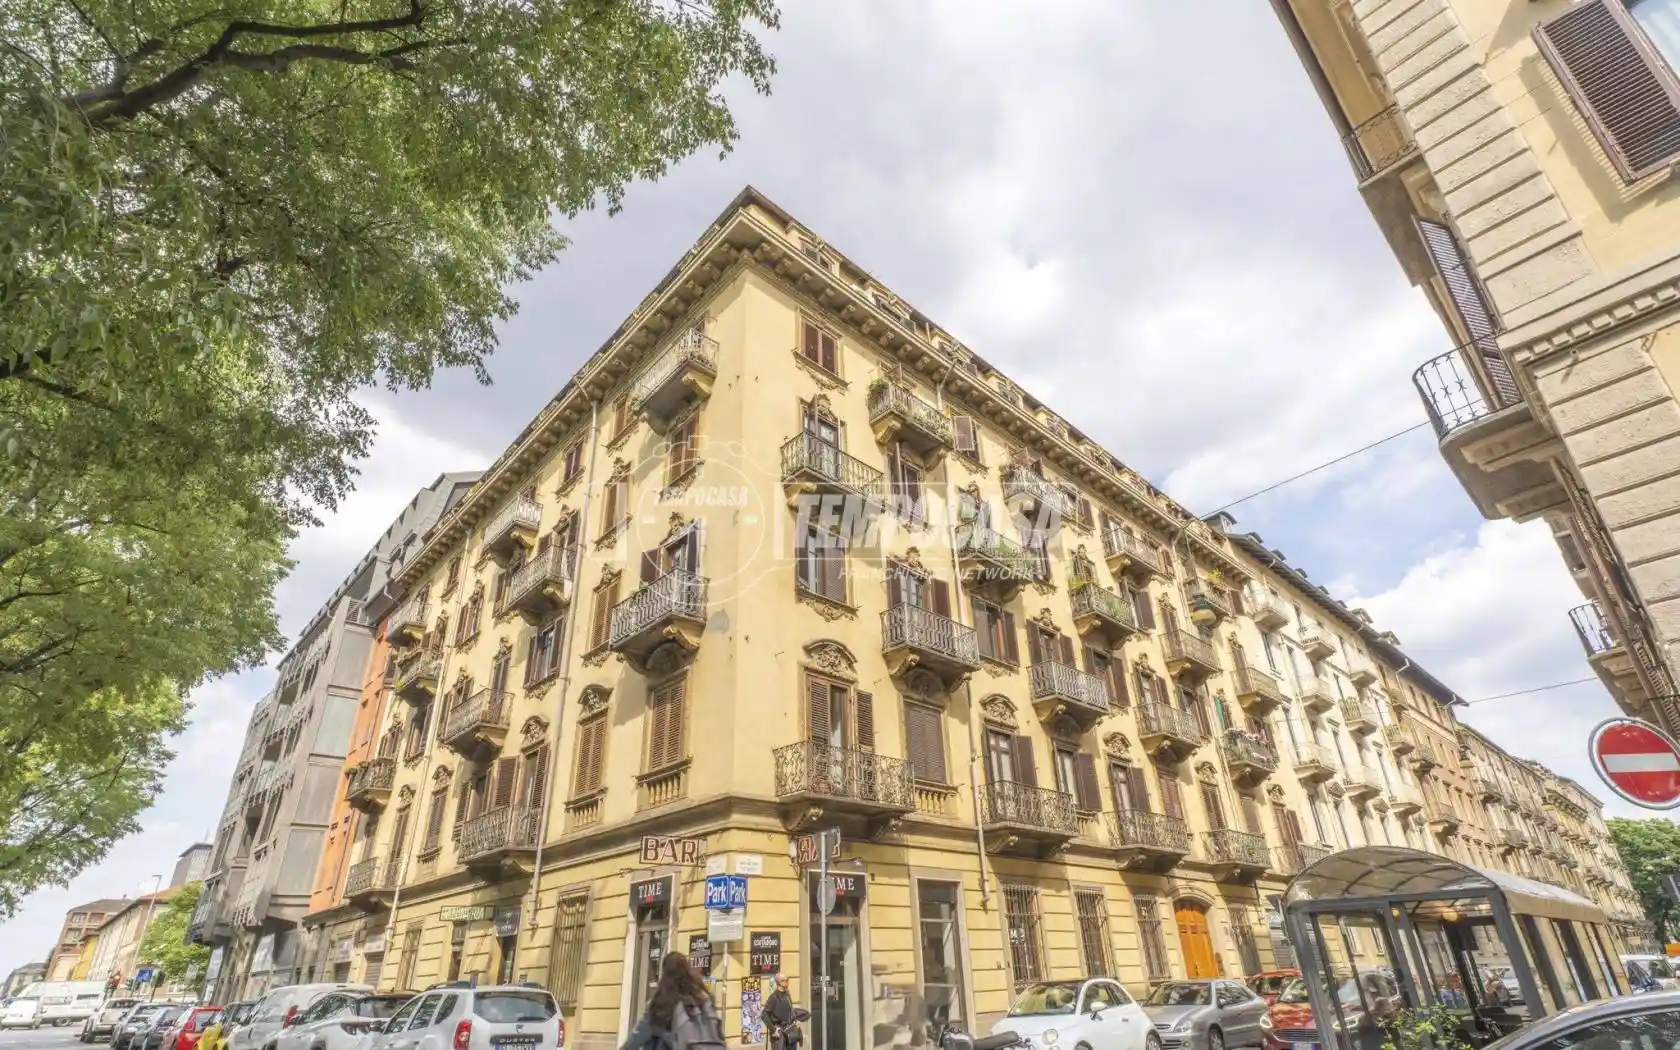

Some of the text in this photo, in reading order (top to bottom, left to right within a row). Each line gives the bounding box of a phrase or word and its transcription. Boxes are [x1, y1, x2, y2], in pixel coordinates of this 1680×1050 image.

[642, 835, 698, 865] BAR
[638, 882, 663, 899] TIME
[730, 881, 746, 903] Park
[831, 876, 855, 891] ME
[707, 882, 727, 904] Park
[690, 956, 709, 968] TIME
[752, 953, 779, 966] TIME
